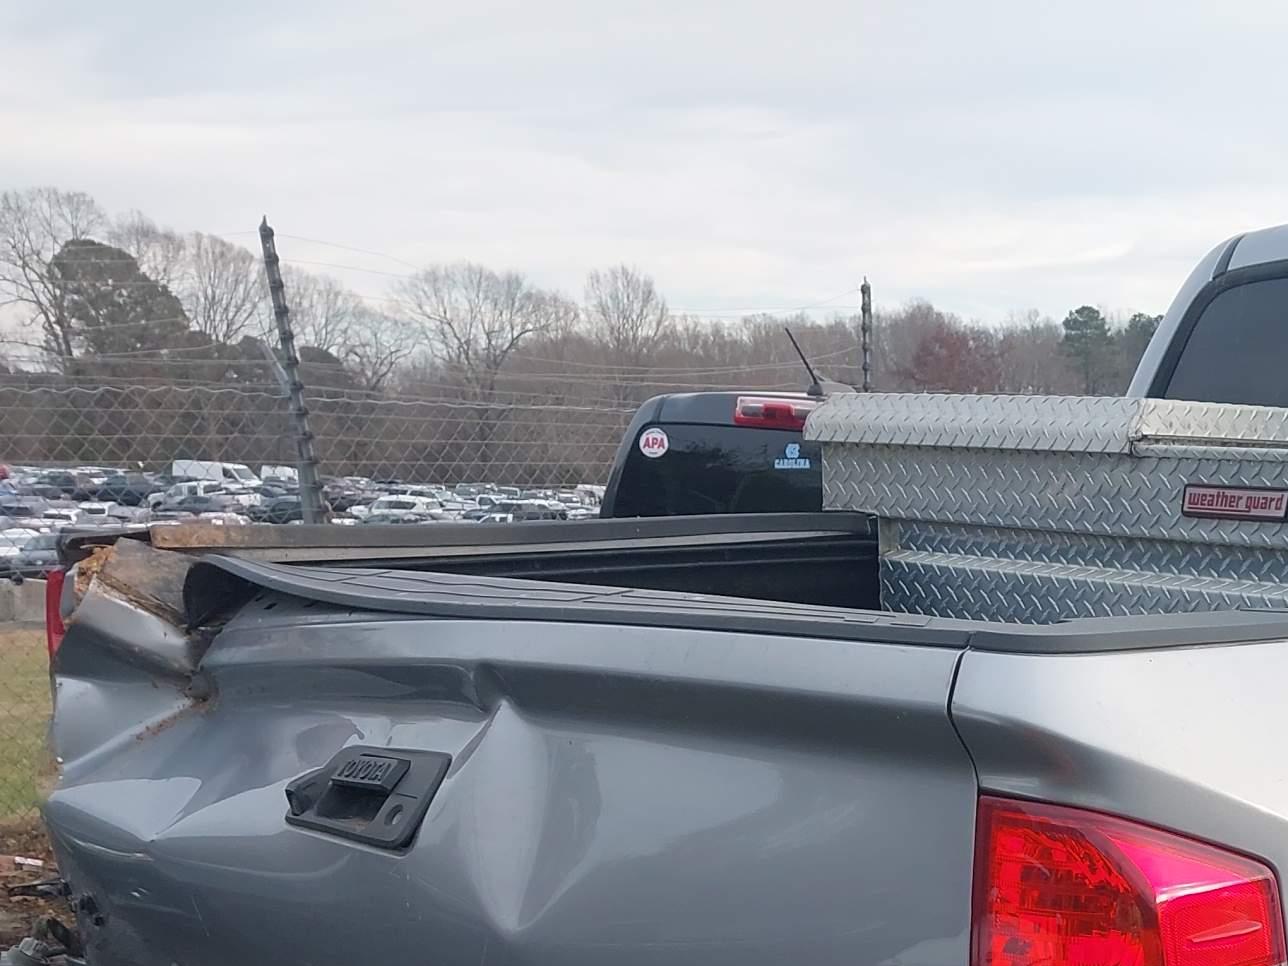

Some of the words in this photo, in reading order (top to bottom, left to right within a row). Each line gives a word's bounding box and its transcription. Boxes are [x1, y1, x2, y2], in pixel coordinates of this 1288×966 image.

[643, 436, 665, 449] APA
[1188, 491, 1242, 508] weather
[1245, 494, 1284, 512] guard
[337, 759, 392, 782] TOYOTA
